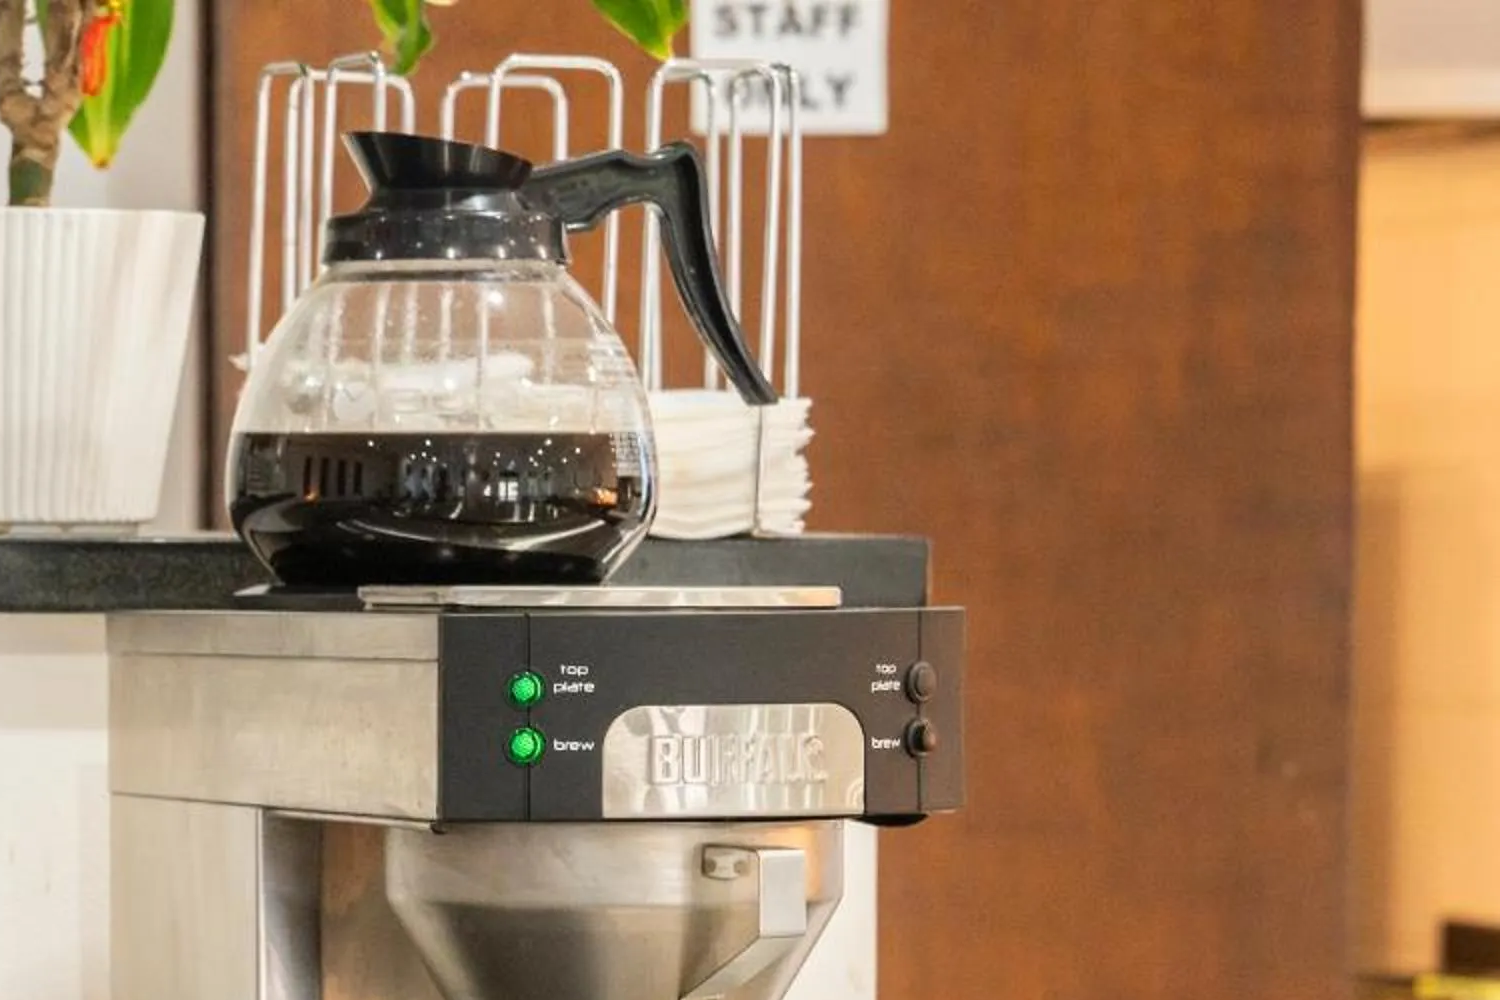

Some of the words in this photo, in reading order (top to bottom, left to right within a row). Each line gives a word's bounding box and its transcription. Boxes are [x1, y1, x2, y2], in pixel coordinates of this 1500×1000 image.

[714, 3, 858, 37] STAFF
[561, 664, 589, 676] top
[876, 664, 897, 674] top
[553, 682, 595, 694] plate
[871, 681, 901, 693] plate
[553, 738, 595, 751] brew
[871, 738, 901, 749] brew
